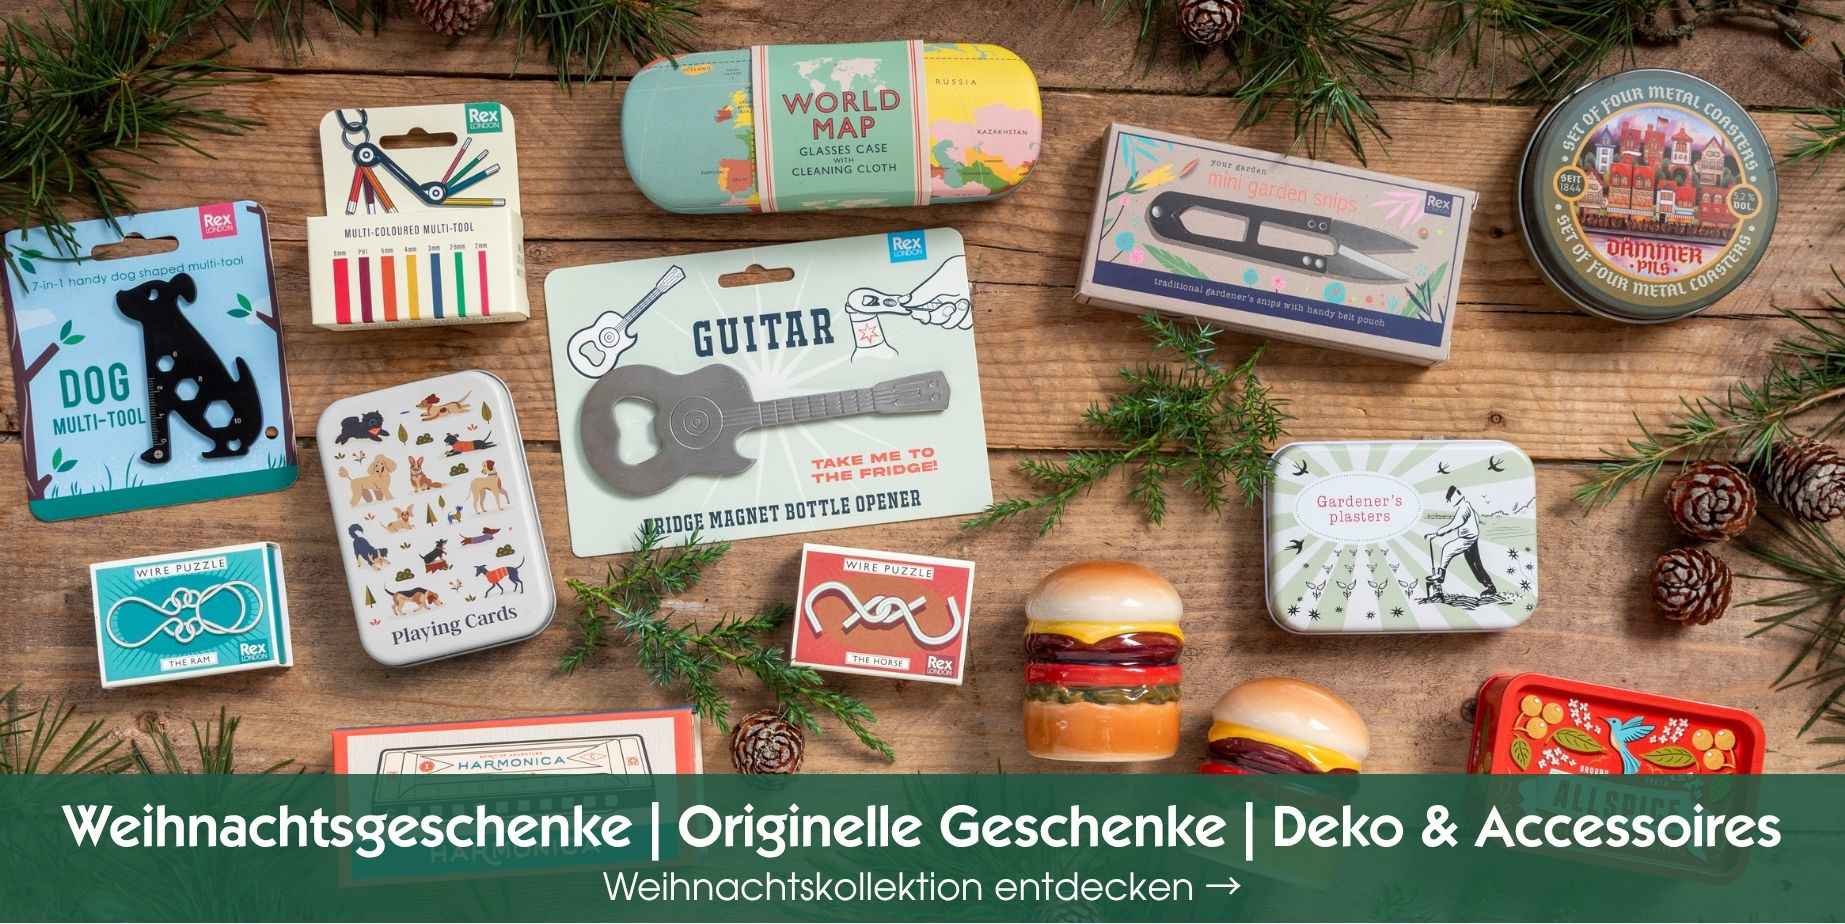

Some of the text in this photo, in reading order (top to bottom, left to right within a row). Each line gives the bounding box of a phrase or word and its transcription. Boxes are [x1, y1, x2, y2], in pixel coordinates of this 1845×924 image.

[936, 78, 977, 86] RUSSIA
[782, 89, 901, 114] WORLD
[469, 109, 498, 123] Rex
[470, 122, 500, 130] LONDON
[813, 117, 877, 140] MAP
[1562, 85, 1759, 171] SET OF FOUR METAL COASTERS
[799, 143, 888, 157] GLASSES CASE
[791, 163, 897, 177] CLEANING CLOTH
[1210, 158, 1268, 175] your garden
[1208, 171, 1359, 215] mini garden snips
[1428, 195, 1450, 211] Rex
[204, 213, 231, 228] Rex
[205, 225, 233, 234] LONDON
[345, 222, 475, 239] MULTI-COLOURED MULTI-TOOL
[892, 235, 921, 251] Rex
[893, 248, 923, 258] LONDON
[1556, 215, 1752, 298] SET OF FOUR METAL COASTERS
[32, 255, 245, 292] 7-in-1 handy dog shaped multi-tool
[1637, 261, 1671, 275] PILS
[1154, 277, 1385, 329] traditional gardener's snips with handy belt pouch
[693, 308, 835, 358] GUITAR
[59, 361, 131, 409] DOG
[53, 407, 147, 436] MULTI-TOOL
[811, 447, 935, 471] TAKE ME TO
[811, 459, 938, 485] THE FRIDGE!
[709, 504, 779, 530] MAGNET
[786, 498, 851, 522] BOTTLE
[856, 490, 921, 515] OPENER
[1317, 495, 1403, 509] Gardener's
[1329, 510, 1391, 525] plasters
[136, 559, 225, 578] WIRE PUZZLE
[846, 560, 932, 578] WIRE PUZZLE
[392, 604, 518, 646] Playing Cards
[240, 642, 266, 656] Rex
[168, 656, 211, 668] THE RAM
[853, 655, 903, 668] THE HORSE
[927, 656, 952, 670] Rex
[458, 755, 566, 772] HARMONICA
